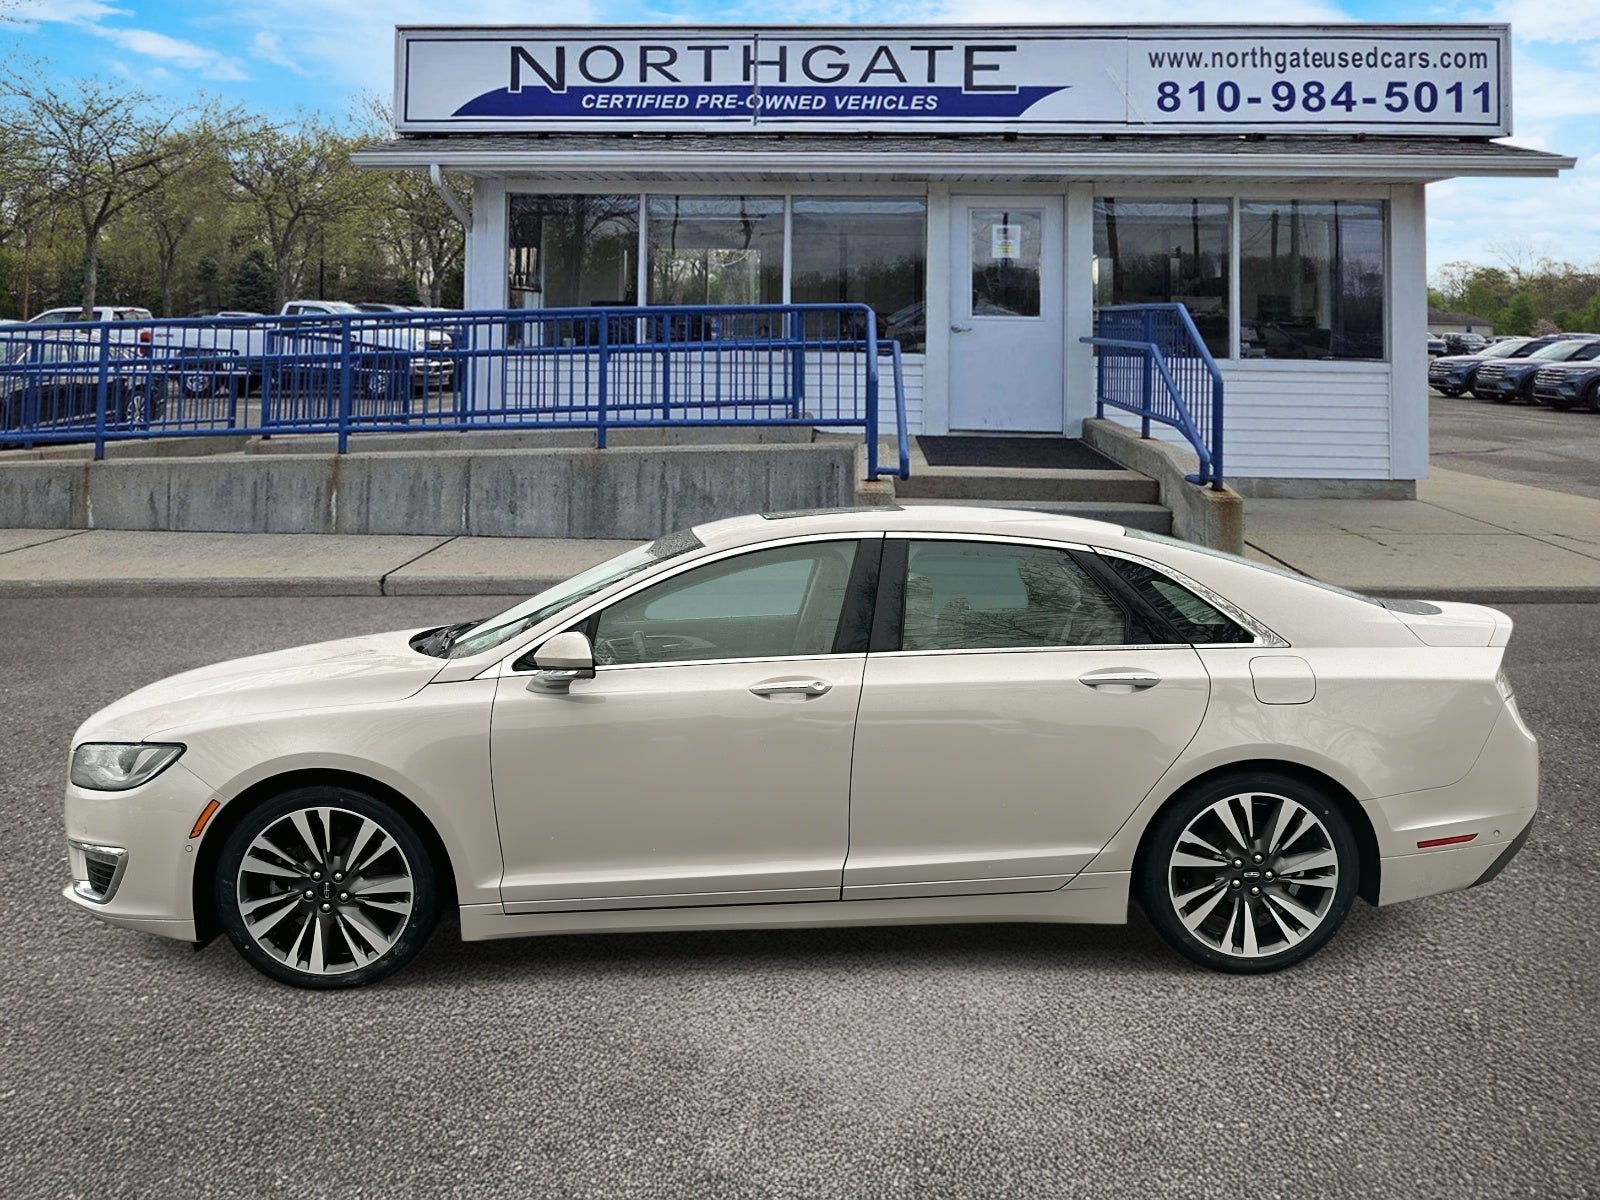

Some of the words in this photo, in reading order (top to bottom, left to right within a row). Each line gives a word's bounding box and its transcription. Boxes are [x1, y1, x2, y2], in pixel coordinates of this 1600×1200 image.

[510, 45, 1017, 92] NORTHGATE
[1148, 47, 1489, 73] www.northgateusedcars.com
[581, 95, 690, 110] CERTIFIED
[695, 94, 827, 110] PRE-OWNED
[834, 95, 938, 110] VEHICLES
[1156, 81, 1491, 113] 810-984-5011
